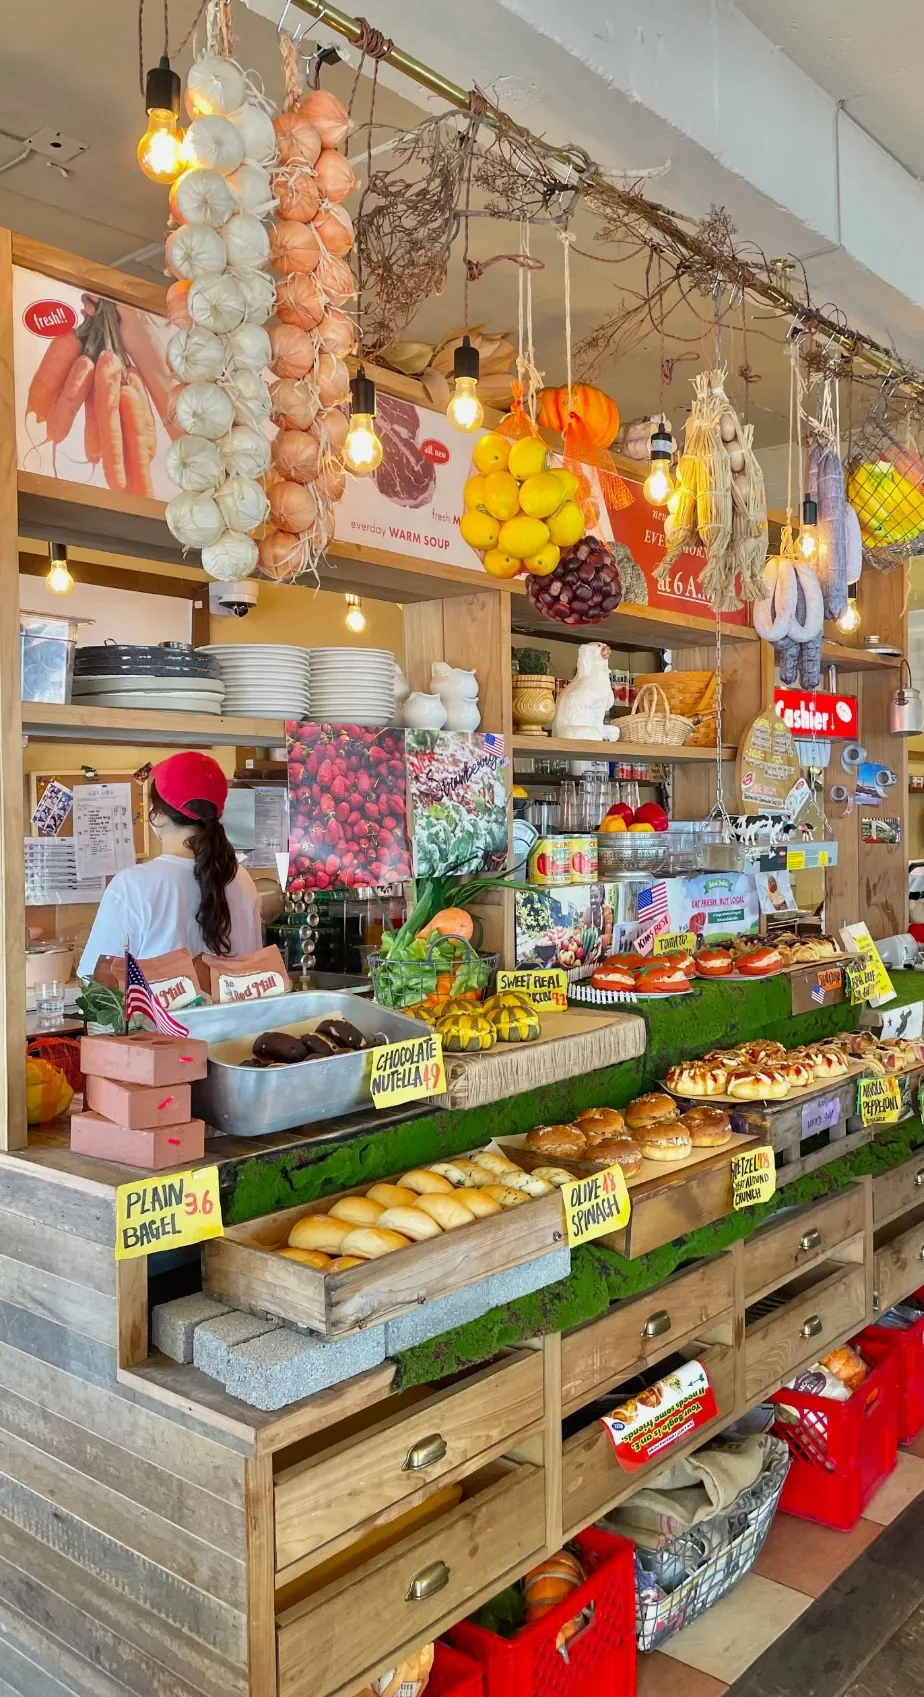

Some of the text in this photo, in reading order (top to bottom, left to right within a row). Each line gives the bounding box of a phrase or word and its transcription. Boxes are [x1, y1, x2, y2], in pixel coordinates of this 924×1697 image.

[33, 307, 68, 330] fresh!!
[424, 444, 447, 459] all new
[432, 508, 451, 523] fresh
[350, 521, 450, 550] everday WARM SOUP
[657, 575, 672, 593] at
[673, 571, 684, 595] 6
[775, 699, 829, 731] Cashier
[653, 914, 669, 936] BEST
[233, 975, 278, 1001] Red Mill
[500, 973, 563, 990] SWEET REAL
[160, 980, 187, 1009] Mill
[376, 1037, 437, 1072] CHOCOLATE
[371, 1065, 424, 1096] NUTELLA
[862, 1096, 899, 1116] PEPPERONI
[126, 1178, 214, 1219] PLAIN 3.6
[570, 1178, 602, 1208] OLIVE
[735, 1188, 762, 1206] CRUNCH
[571, 1194, 621, 1237] SPINACH
[122, 1212, 183, 1249] BAGEL
[675, 1390, 699, 1409] needs
[684, 1403, 702, 1416] Your
[654, 1407, 676, 1422] some
[662, 1416, 684, 1432] Bagle
[621, 1420, 655, 1443] friends.
[640, 1434, 653, 1445] an
[631, 1441, 641, 1451] E.
